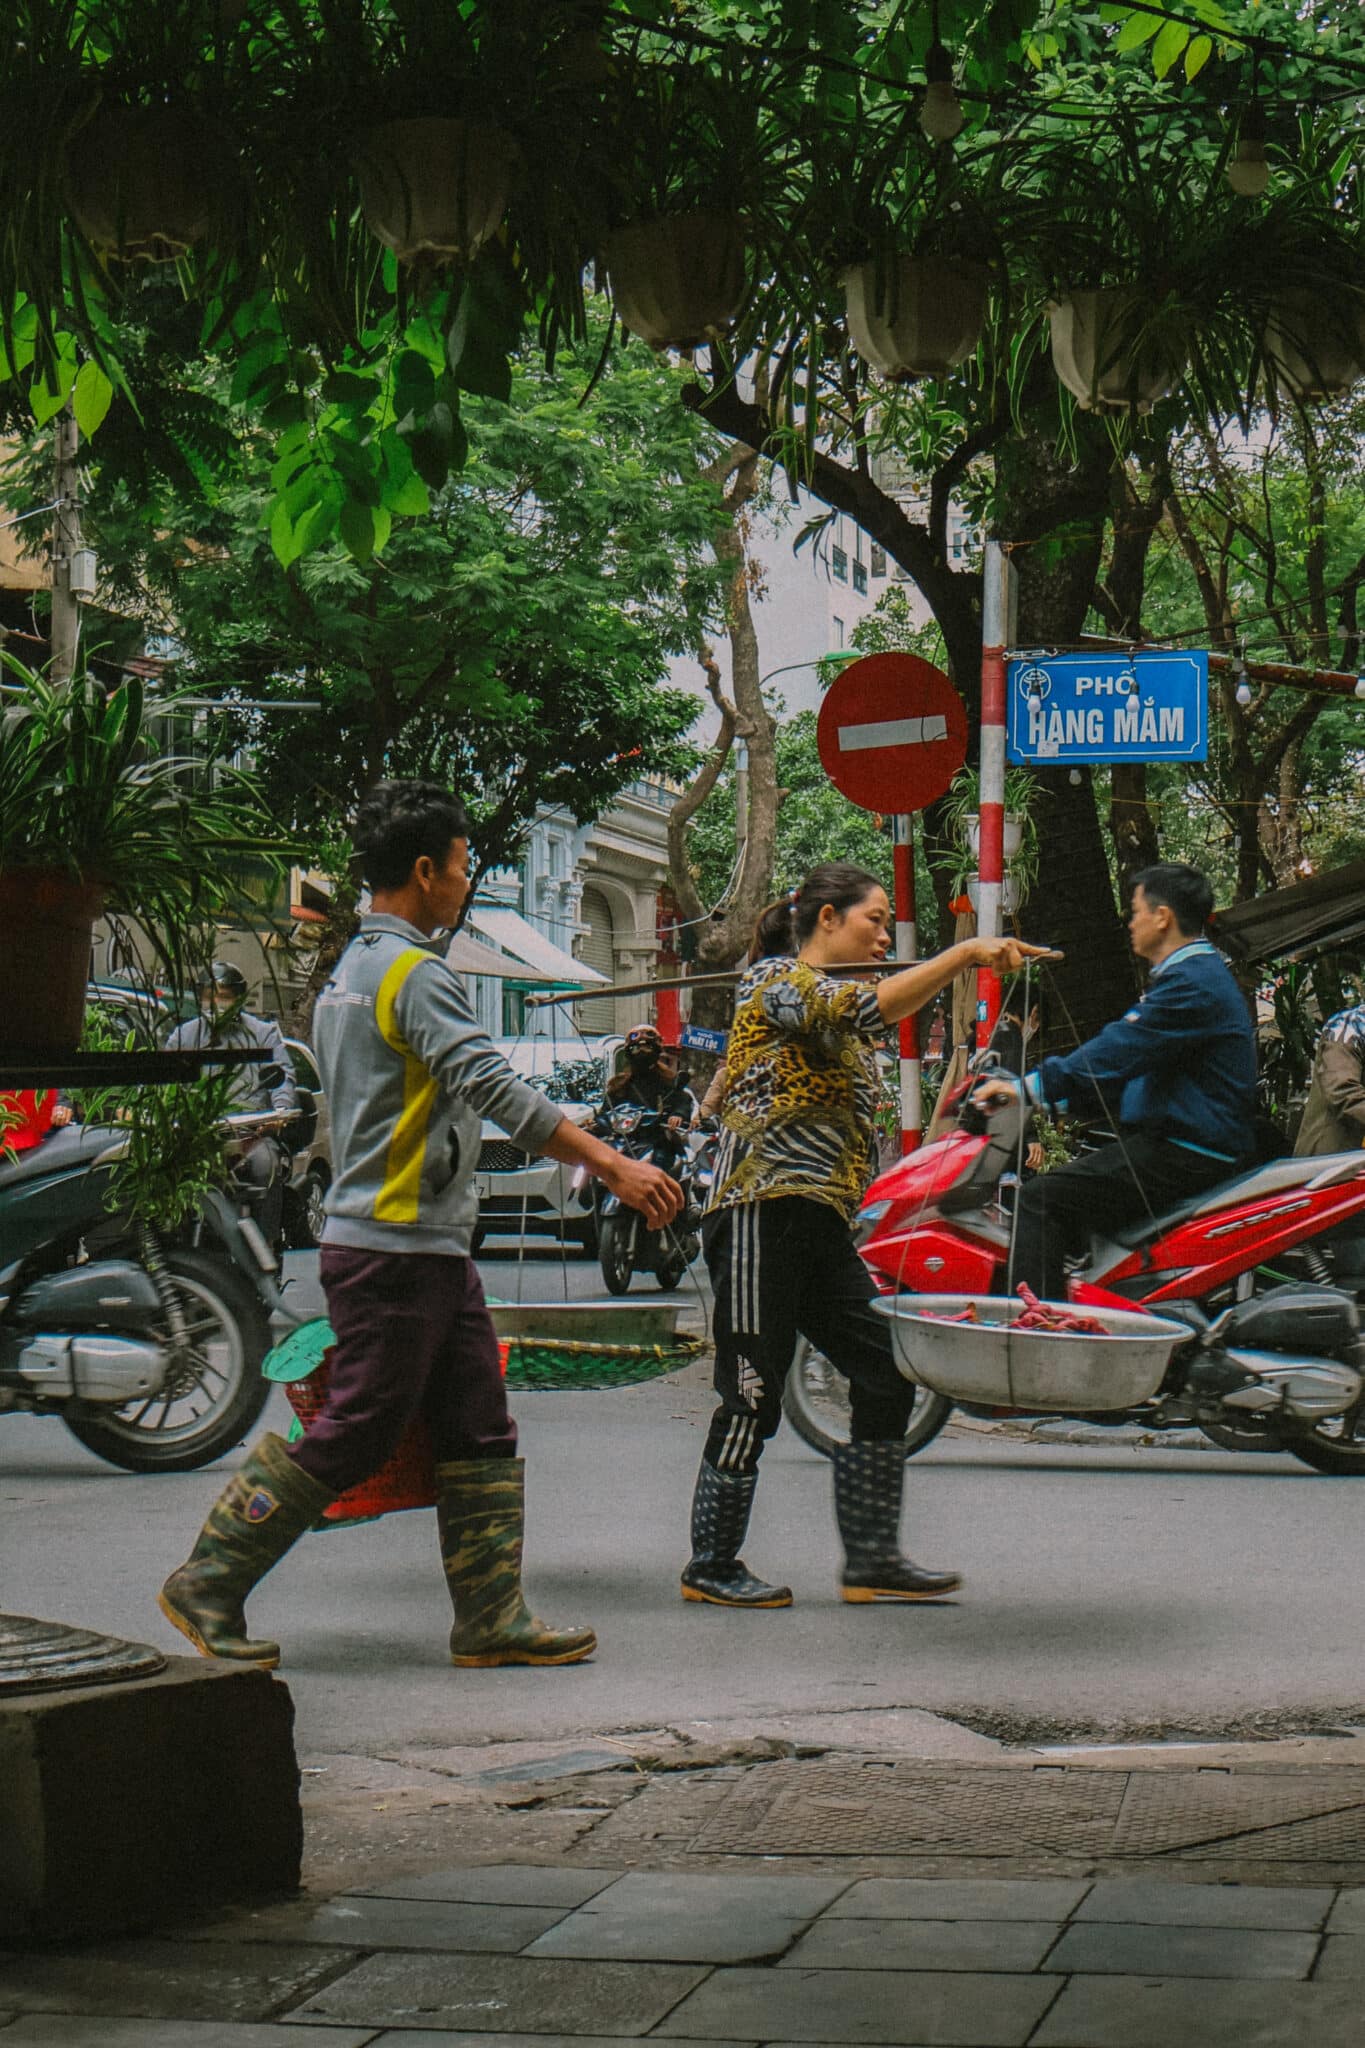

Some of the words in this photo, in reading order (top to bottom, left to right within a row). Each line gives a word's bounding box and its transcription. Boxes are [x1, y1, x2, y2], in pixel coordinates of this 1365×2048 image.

[1075, 667, 1137, 696] PHỐ
[1029, 703, 1104, 745] HÀNG
[1114, 696, 1185, 744] MẮM
